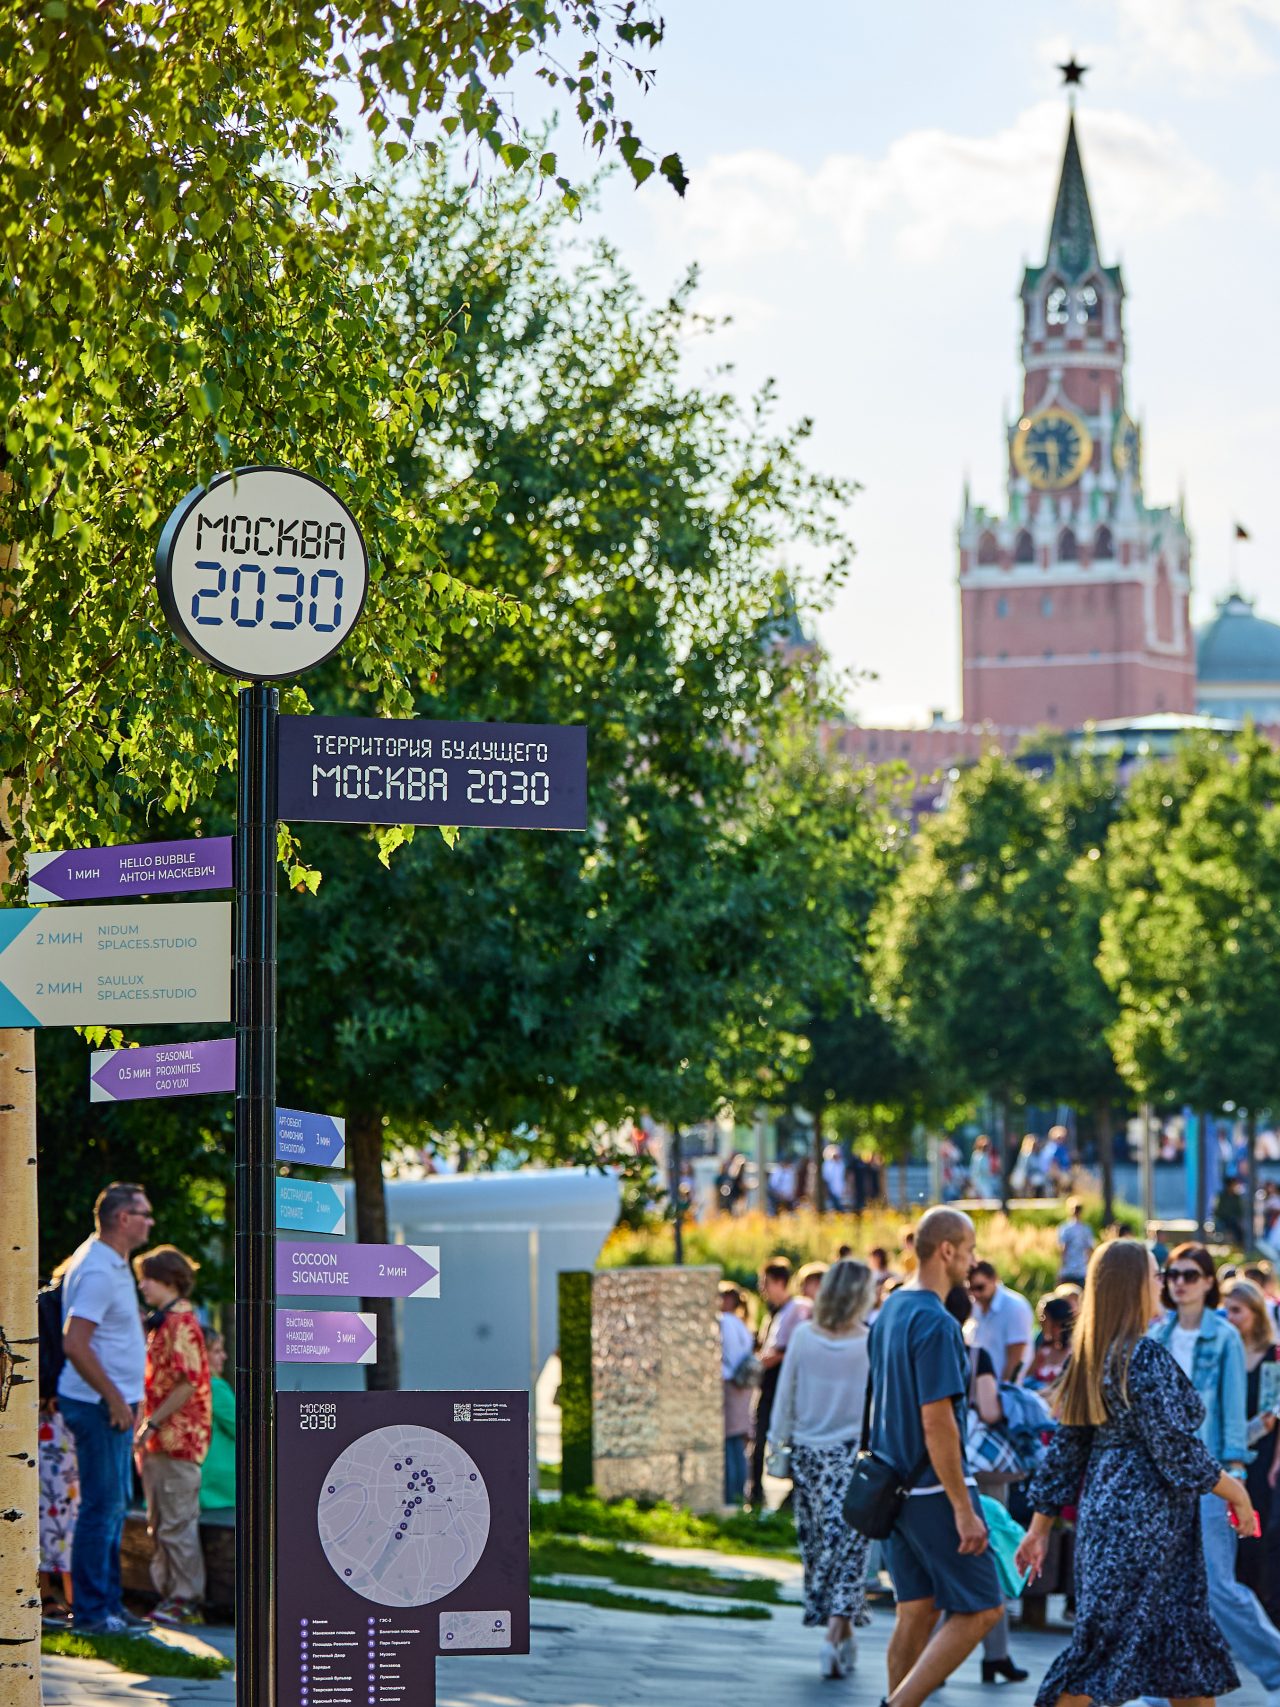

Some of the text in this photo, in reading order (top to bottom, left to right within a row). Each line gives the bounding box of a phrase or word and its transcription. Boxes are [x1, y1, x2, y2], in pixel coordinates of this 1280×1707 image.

[196, 513, 346, 560] МОСКВА
[191, 561, 344, 632] 2030
[313, 735, 548, 763] ТЕРРИТОРИЯ БУДУЩЕГО
[312, 764, 549, 805] МОСКВА 2030
[119, 853, 196, 868] HELLO BUBBLE
[67, 868, 72, 880] 1
[119, 865, 216, 882] АНТОН МАСКЕВИЧ
[98, 925, 139, 935] NIDUM
[36, 933, 83, 945] 2 МИН
[97, 938, 198, 950] SPLACES.STUDIO
[97, 976, 144, 986] SAULUX
[36, 982, 83, 995] 2 МИН
[97, 988, 198, 1001] SPLACES.STUDIO
[156, 1050, 194, 1062] SEASONAL
[156, 1063, 201, 1077] PROXIMITIES
[155, 1078, 189, 1090] CAO YUXI
[316, 1133, 320, 1145] 3
[292, 1253, 338, 1266] COCOON
[378, 1264, 385, 1276] 2
[292, 1271, 350, 1284] SIGNATURE
[286, 1318, 314, 1328] ВЫСТАВКА
[336, 1331, 342, 1343] 3
[300, 1404, 337, 1414] МОСКВА
[300, 1415, 336, 1430] 2030
